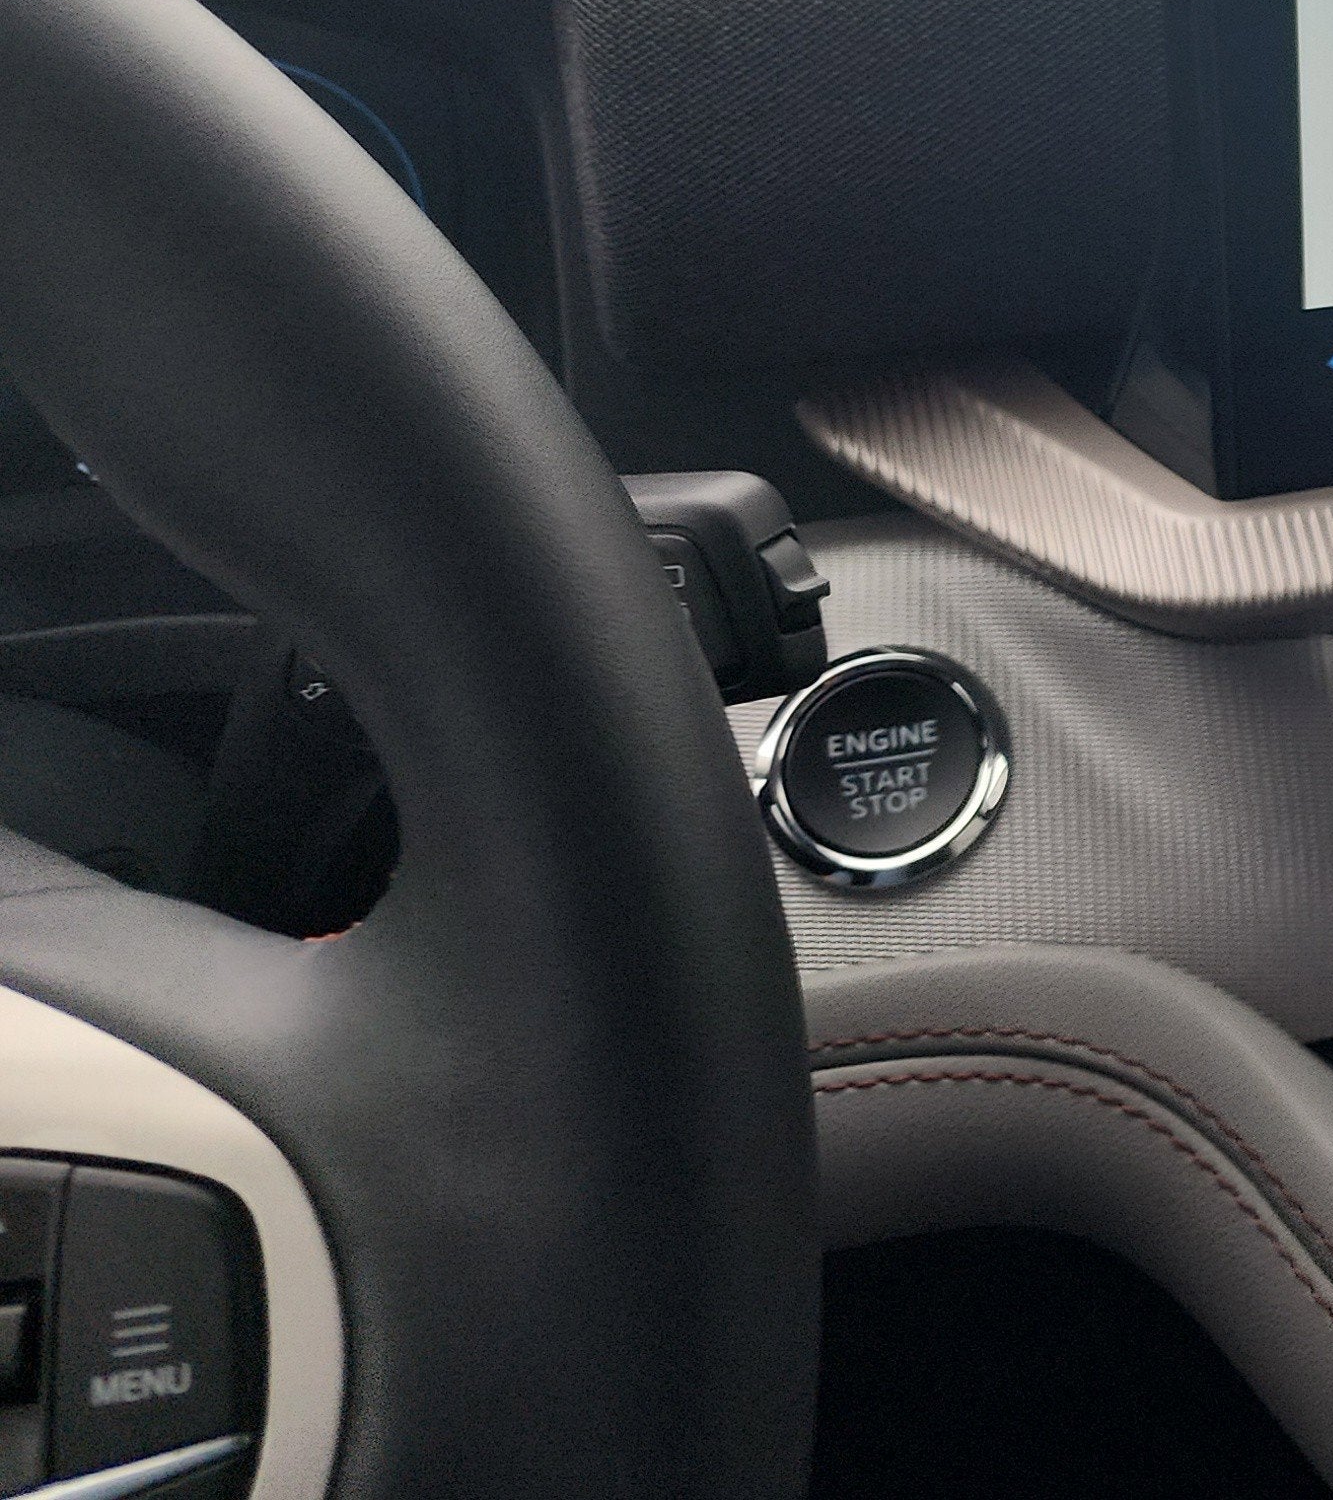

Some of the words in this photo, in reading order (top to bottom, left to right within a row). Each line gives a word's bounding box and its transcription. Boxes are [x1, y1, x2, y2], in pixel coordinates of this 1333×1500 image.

[828, 720, 938, 757] ENGINE
[840, 762, 930, 797] START
[848, 786, 929, 819] STOP
[90, 1362, 192, 1406] MENU
